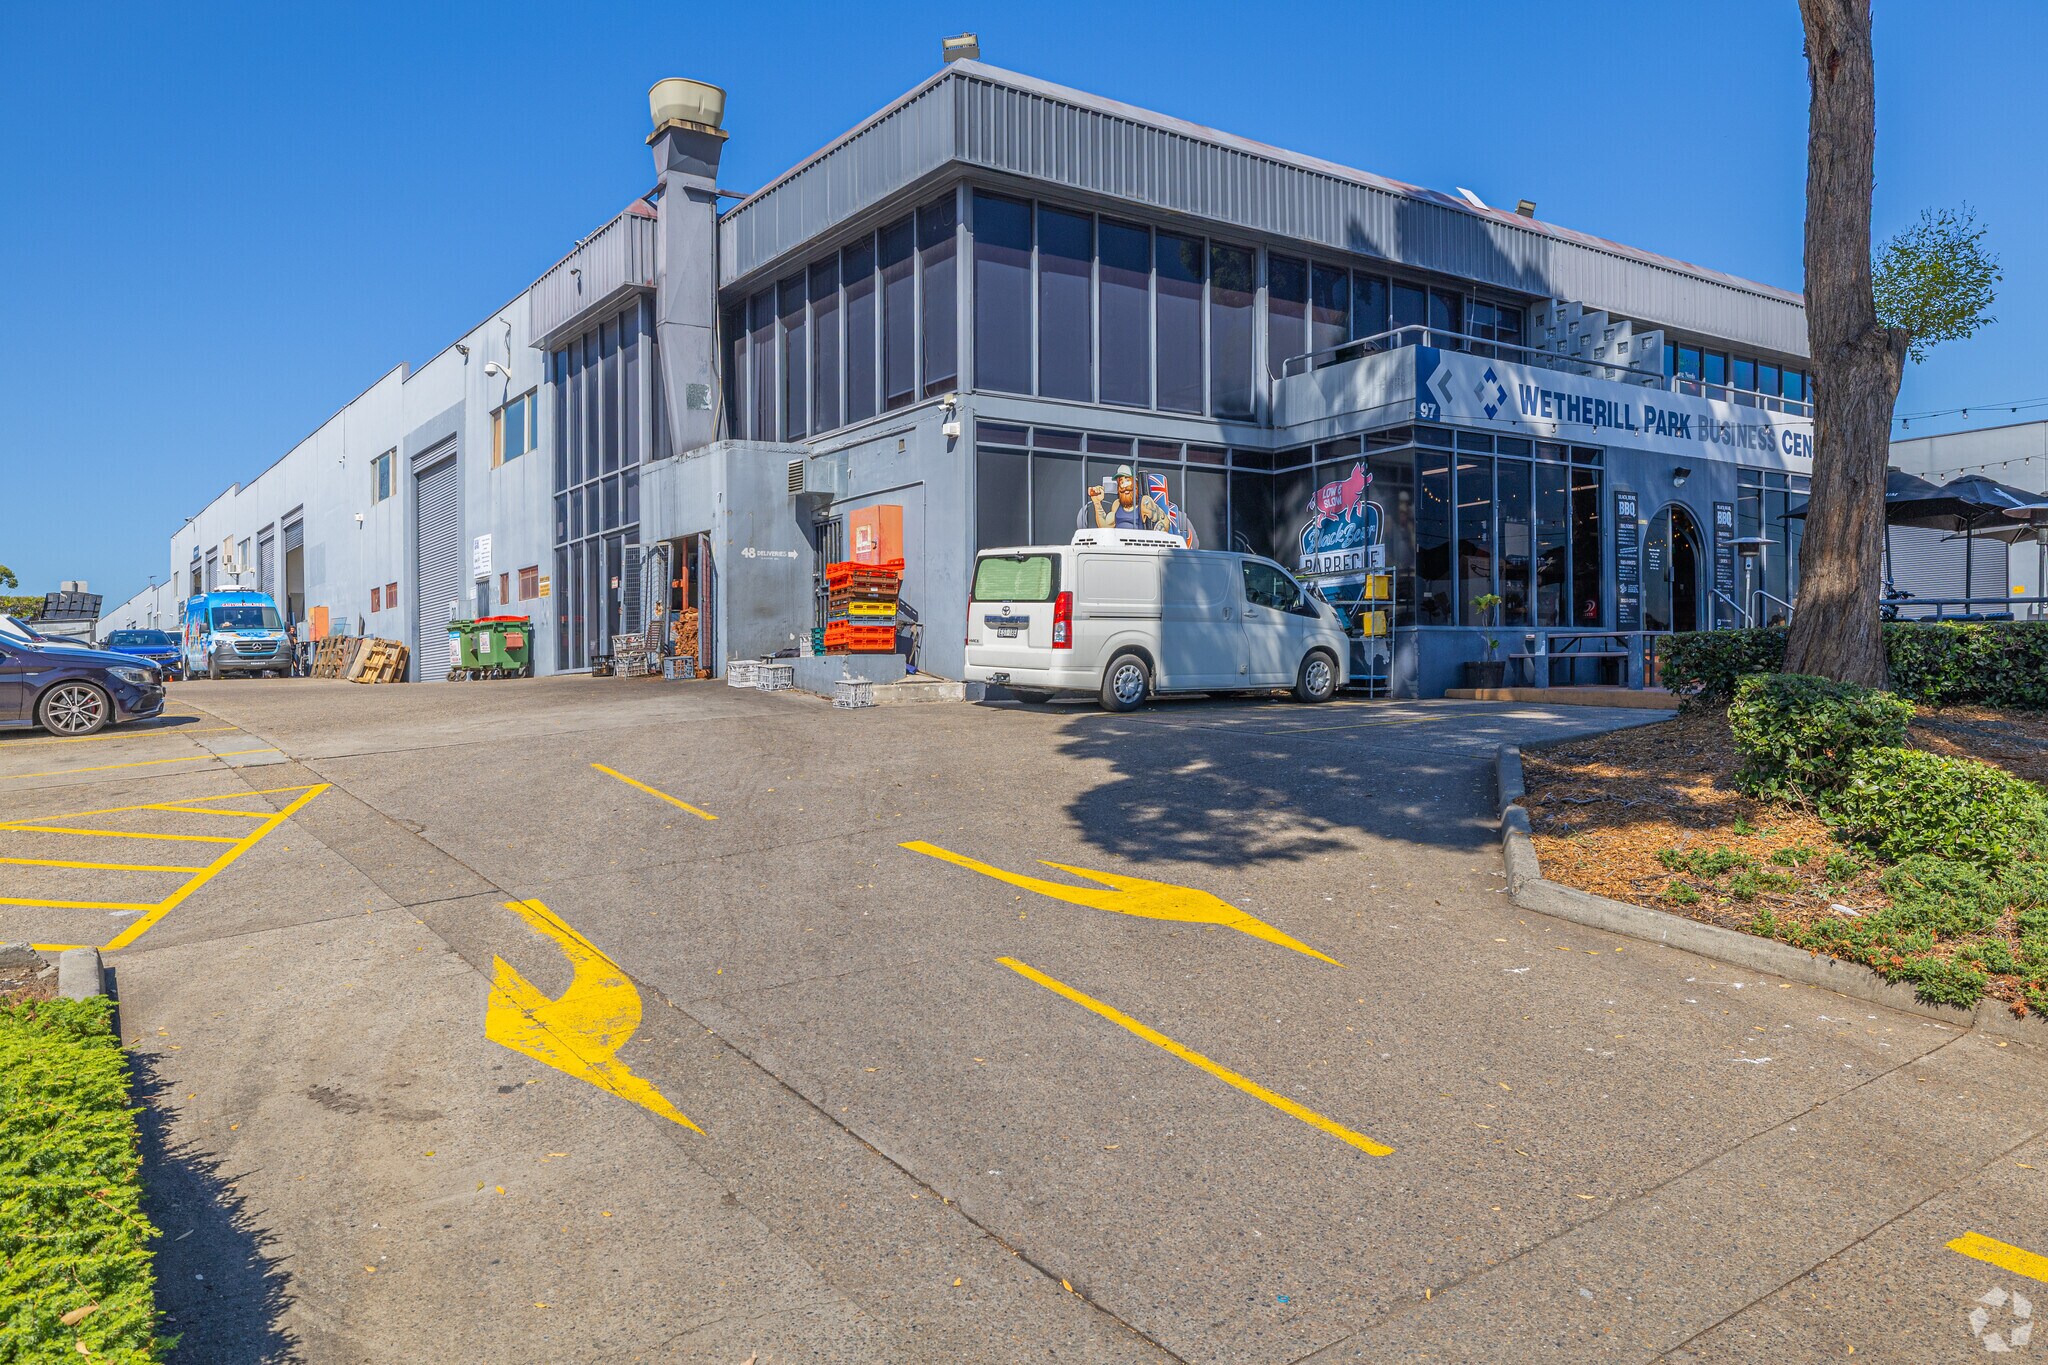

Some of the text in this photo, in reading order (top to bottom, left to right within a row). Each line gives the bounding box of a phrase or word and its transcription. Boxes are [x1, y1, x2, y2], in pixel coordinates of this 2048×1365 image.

[1420, 402, 1436, 419] 97
[1518, 383, 1635, 431] WETHERILL
[1644, 404, 1691, 440] PARK
[1697, 414, 1776, 452] BUSINESS
[1323, 486, 1337, 498] LOW
[1324, 496, 1342, 508] SLOW
[1618, 501, 1636, 517] BBQ
[1717, 511, 1732, 527] BBQ
[1306, 523, 1344, 553] Black
[741, 547, 756, 558] 48
